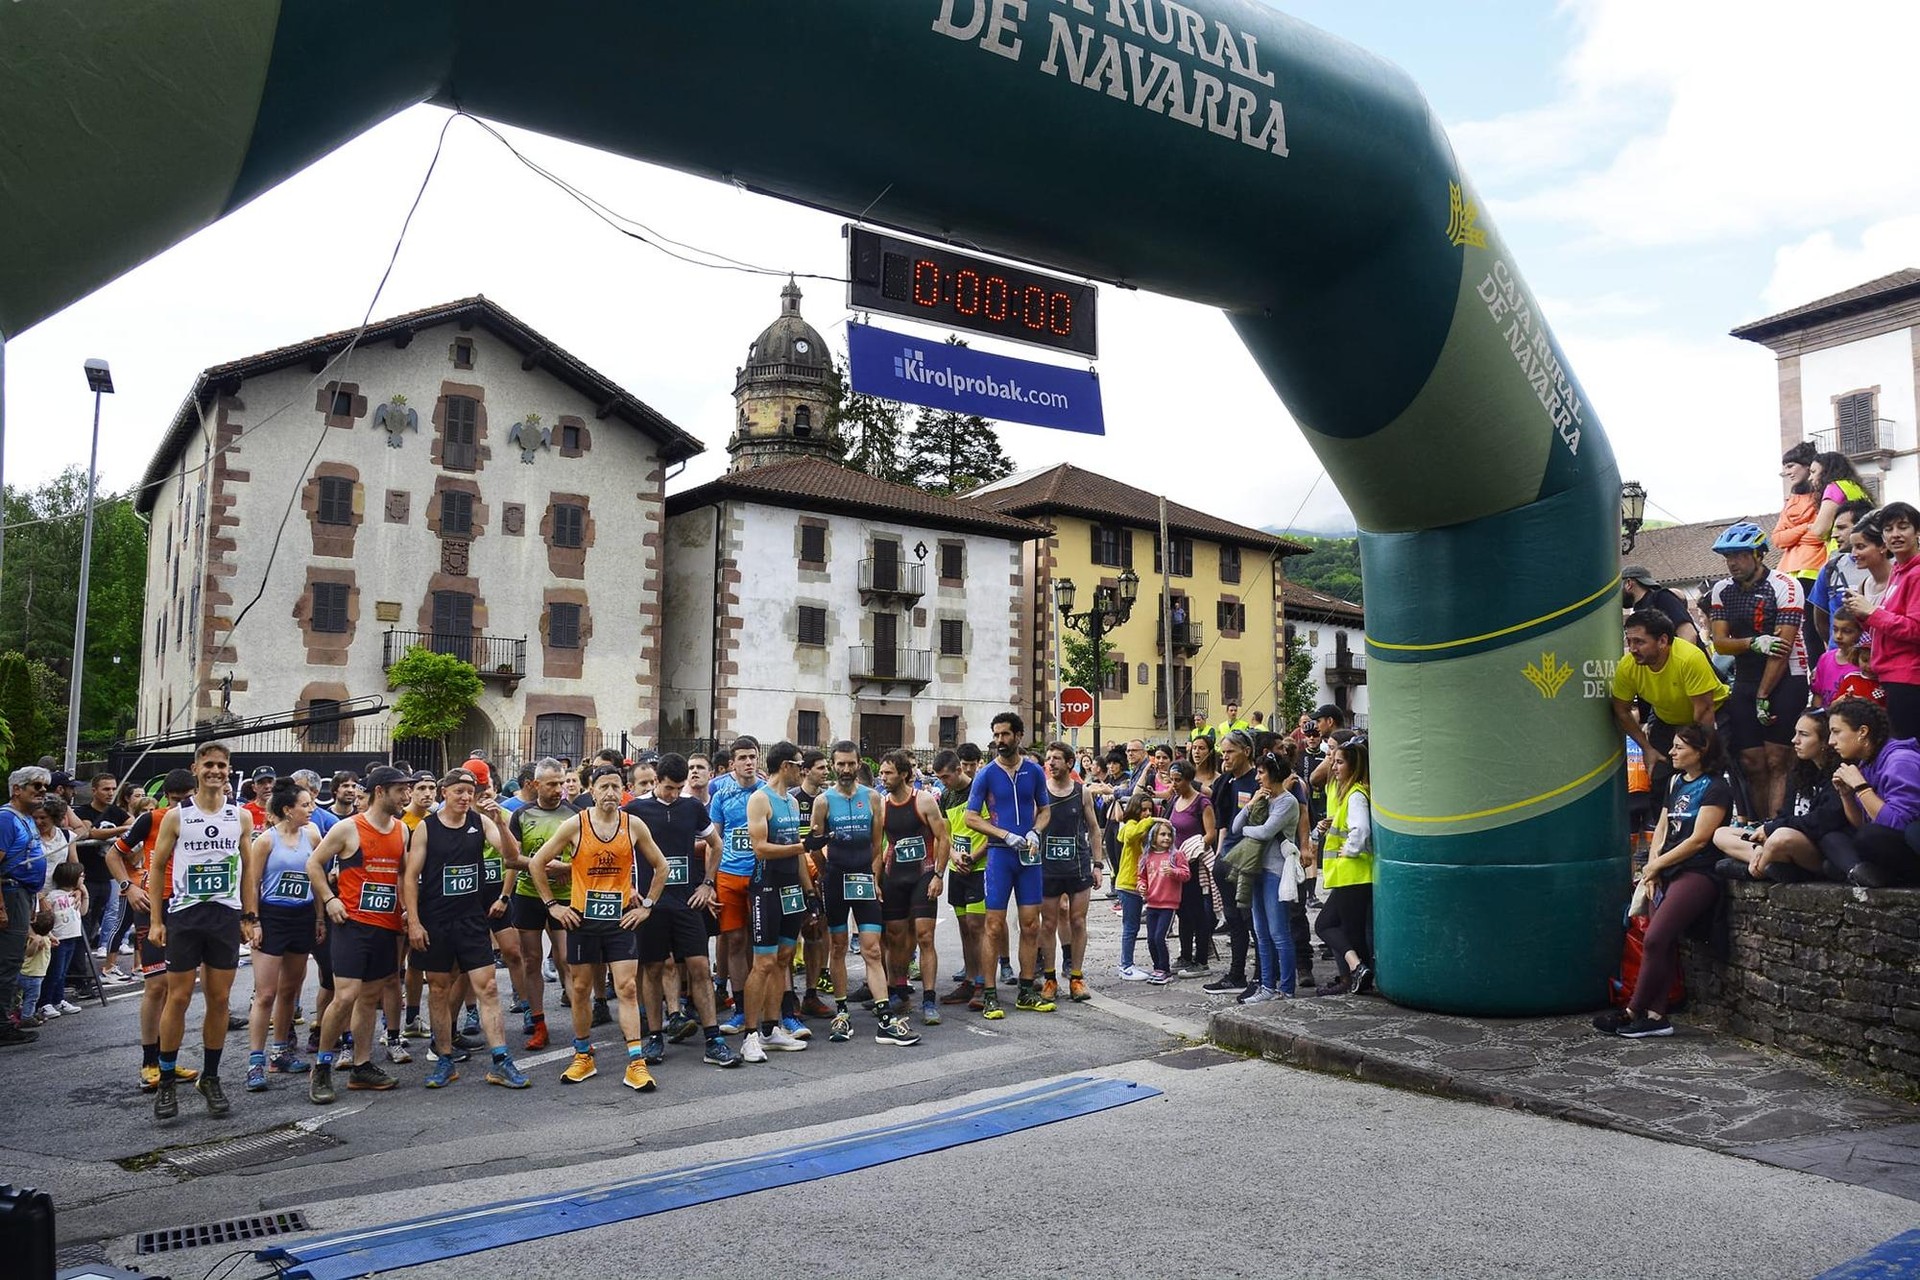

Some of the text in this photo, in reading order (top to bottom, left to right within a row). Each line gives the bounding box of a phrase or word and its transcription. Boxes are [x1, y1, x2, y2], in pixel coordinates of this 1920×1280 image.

[1106, 0, 1275, 87] RURAL
[932, 0, 1290, 158] DE NAVARRA
[914, 260, 1071, 336] 0:00:00
[1493, 259, 1583, 425] CAJA RURAL
[1476, 272, 1582, 456] DE NAVARRA
[903, 357, 1069, 409] Kirolprobak.com
[1583, 680, 1606, 698] DE
[1060, 702, 1090, 713] STOP
[902, 847, 917, 859] 11
[1050, 847, 1071, 858] 134
[195, 876, 223, 891] 113
[280, 881, 303, 896] 110
[450, 876, 474, 891] 102
[856, 884, 865, 896] 8
[367, 895, 391, 909] 105
[591, 903, 616, 916] 123
[791, 896, 799, 909] 4
